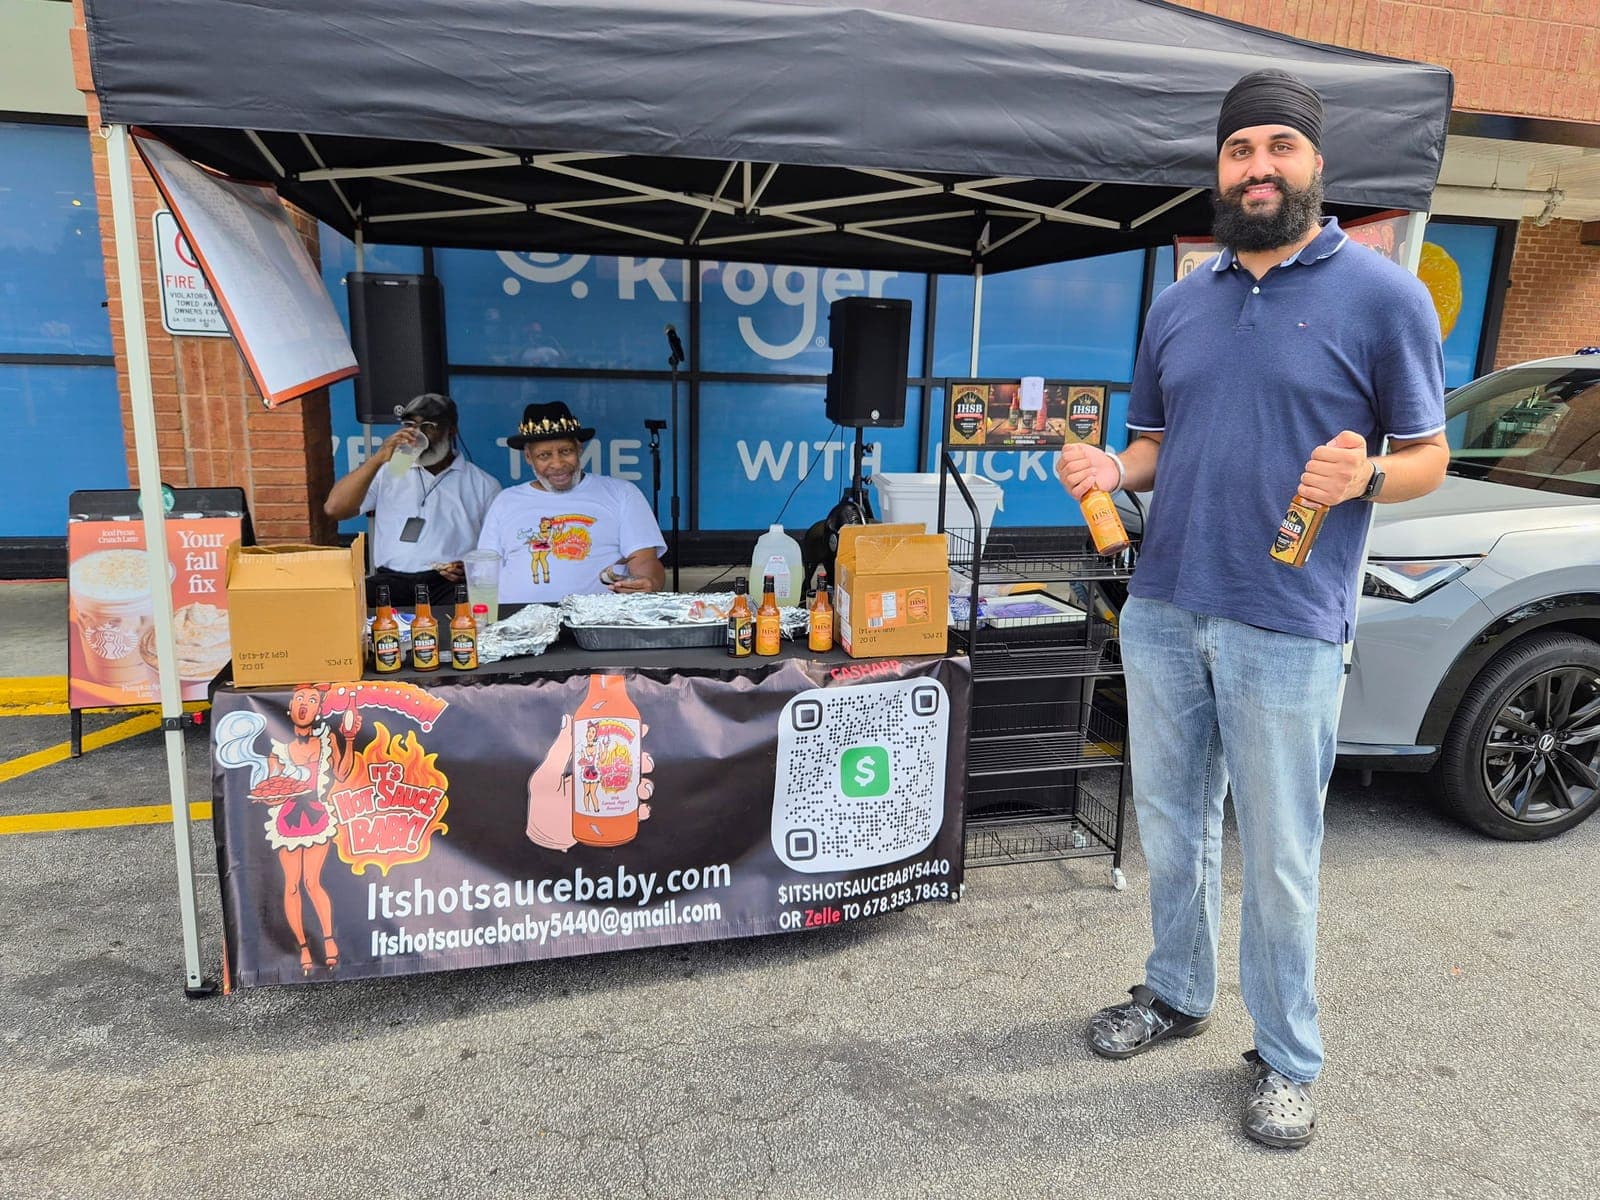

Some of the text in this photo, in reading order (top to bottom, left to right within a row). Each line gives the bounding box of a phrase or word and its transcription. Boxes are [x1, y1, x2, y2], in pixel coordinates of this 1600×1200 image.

[165, 275, 196, 289] FIRE
[618, 256, 898, 360] Kroger
[957, 403, 983, 413] IHSB
[1072, 404, 1099, 414] IHSB
[736, 440, 882, 482] WITH
[177, 530, 224, 548] Your
[185, 551, 218, 571] fall
[188, 575, 217, 594] fix
[830, 659, 900, 681] CASHAPP
[369, 762, 404, 784] IT'S
[332, 786, 377, 824] HOT
[350, 812, 432, 854] BABY!
[367, 863, 732, 921] Itshotsaucebaby.com
[778, 859, 950, 906] $ITSHOTSAUCEBABY5440
[779, 882, 949, 930] OR Zelle TO 678.353.7863
[371, 901, 722, 957] Itshotsaucebaby5440@gmail.com
